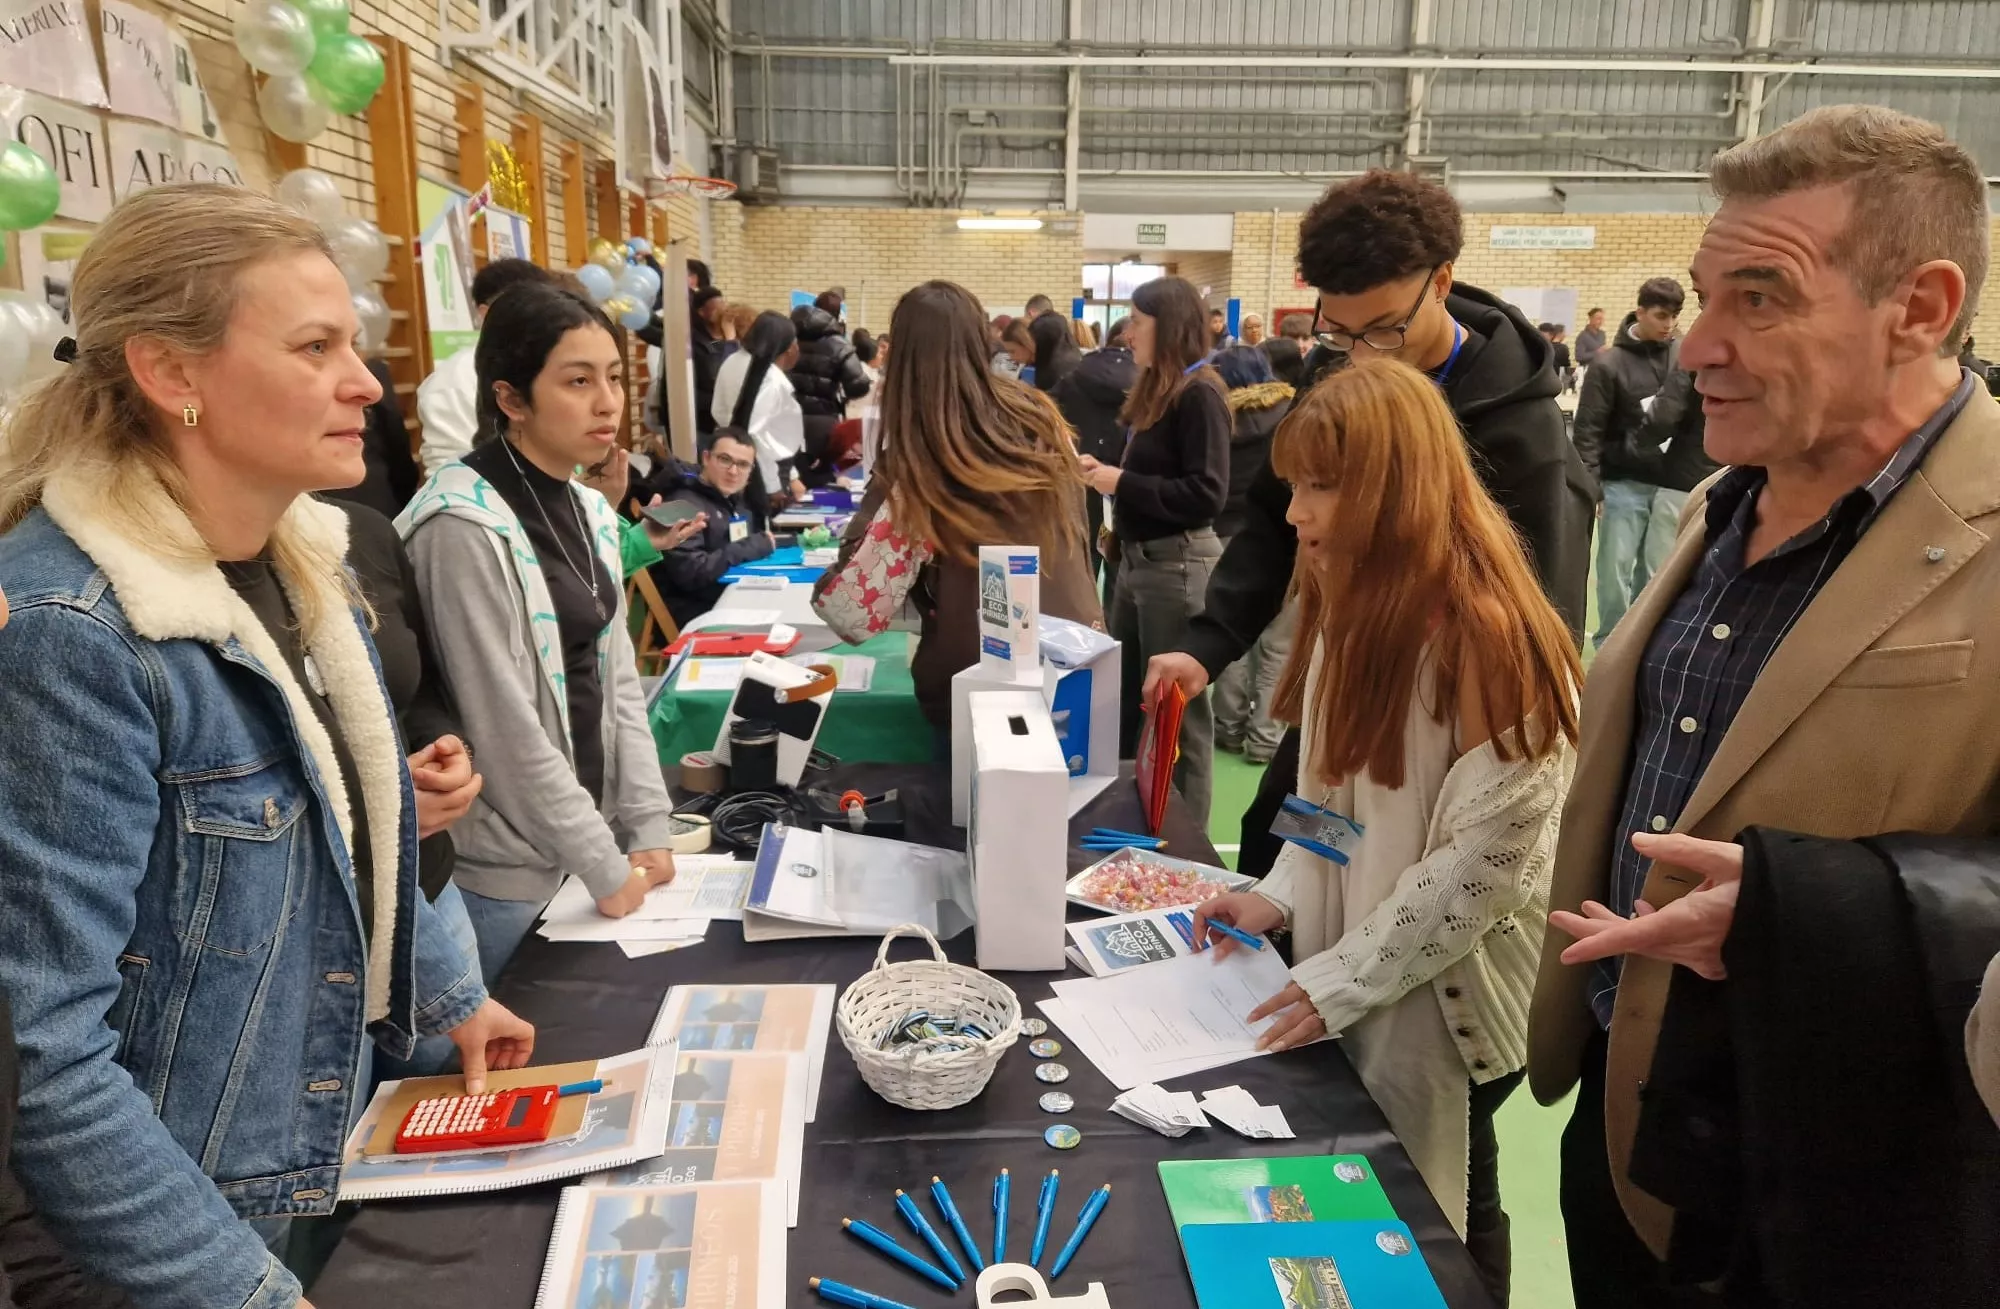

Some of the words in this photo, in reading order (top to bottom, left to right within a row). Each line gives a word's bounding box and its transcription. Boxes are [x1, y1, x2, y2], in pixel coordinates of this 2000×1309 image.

[988, 601, 1003, 612] ECO
[1134, 930, 1153, 951] ECO
[1136, 919, 1171, 960] PIRINEOS
